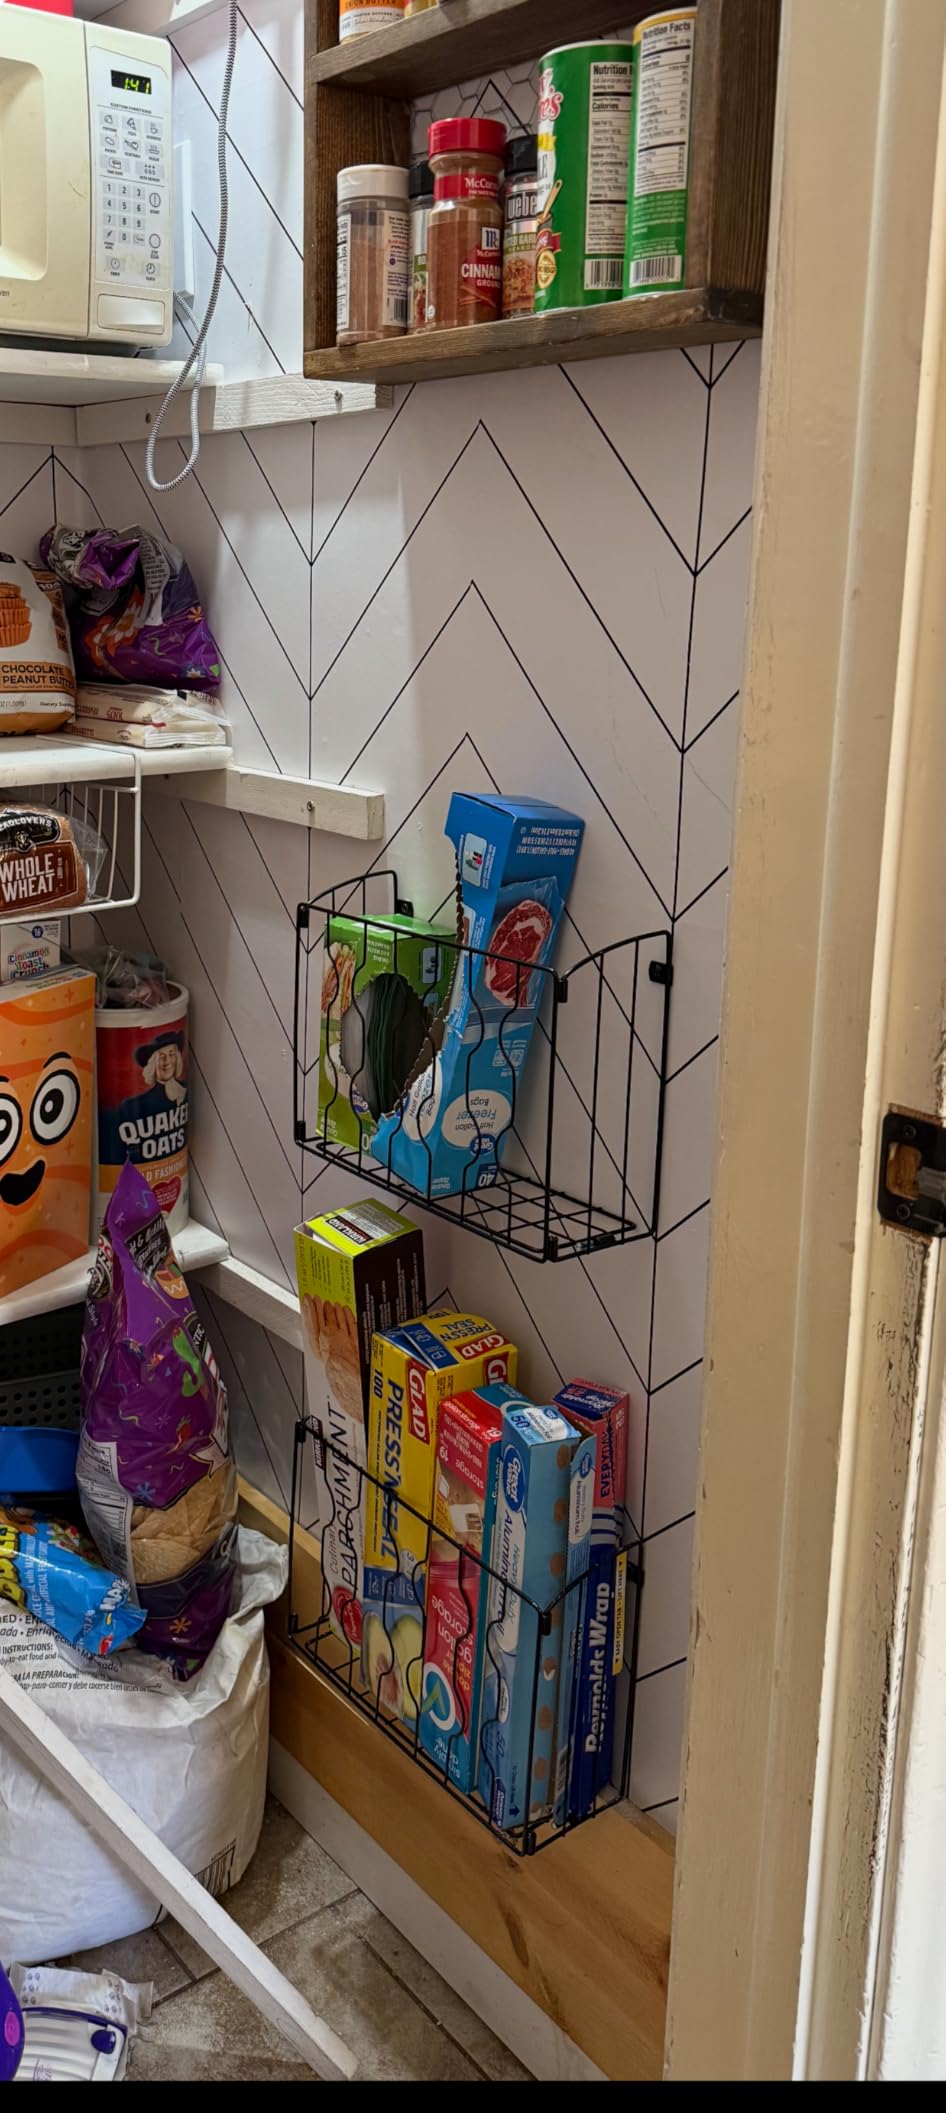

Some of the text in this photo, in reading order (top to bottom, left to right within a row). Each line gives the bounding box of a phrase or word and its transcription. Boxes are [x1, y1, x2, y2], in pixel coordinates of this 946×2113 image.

[669, 22, 691, 32] Facts
[593, 65, 628, 76] Nutrition
[591, 102, 619, 110] Calories
[108, 184, 141, 197] 1 2 3
[107, 199, 141, 212] 4 5 6
[107, 215, 141, 228] 7 8 9
[122, 233, 127, 241] 0
[1, 664, 65, 676] CHOCOLATE
[3, 675, 46, 684] PEANUT
[0, 853, 55, 883] WHOLE
[2, 872, 56, 903] WHEAT
[8, 947, 50, 965] Cinnamon
[15, 957, 43, 971] Toast
[470, 1097, 490, 1106] Bags
[142, 1128, 185, 1159] OATS
[480, 1173, 495, 1187] 40
[329, 1218, 367, 1245] KIRKLAND
[441, 1318, 476, 1331] SEAL
[441, 1322, 493, 1342] PRESS'N
[461, 1335, 505, 1357] GLAD
[373, 1368, 383, 1399] 100
[409, 1368, 426, 1438] GLAD
[510, 1415, 531, 1429] 50
[439, 1445, 449, 1462] 19
[455, 1459, 485, 1489] storage
[505, 1462, 514, 1494] Value
[511, 1457, 521, 1503] Great
[589, 1582, 611, 1648] Wrap
[2, 1642, 53, 1656] INSTRUCTIONS:
[29, 1654, 43, 1662] food
[43, 1652, 57, 1661] and
[22, 1672, 31, 1681] LA
[73, 1681, 87, 1691] debe
[88, 1682, 110, 1692] cocerse
